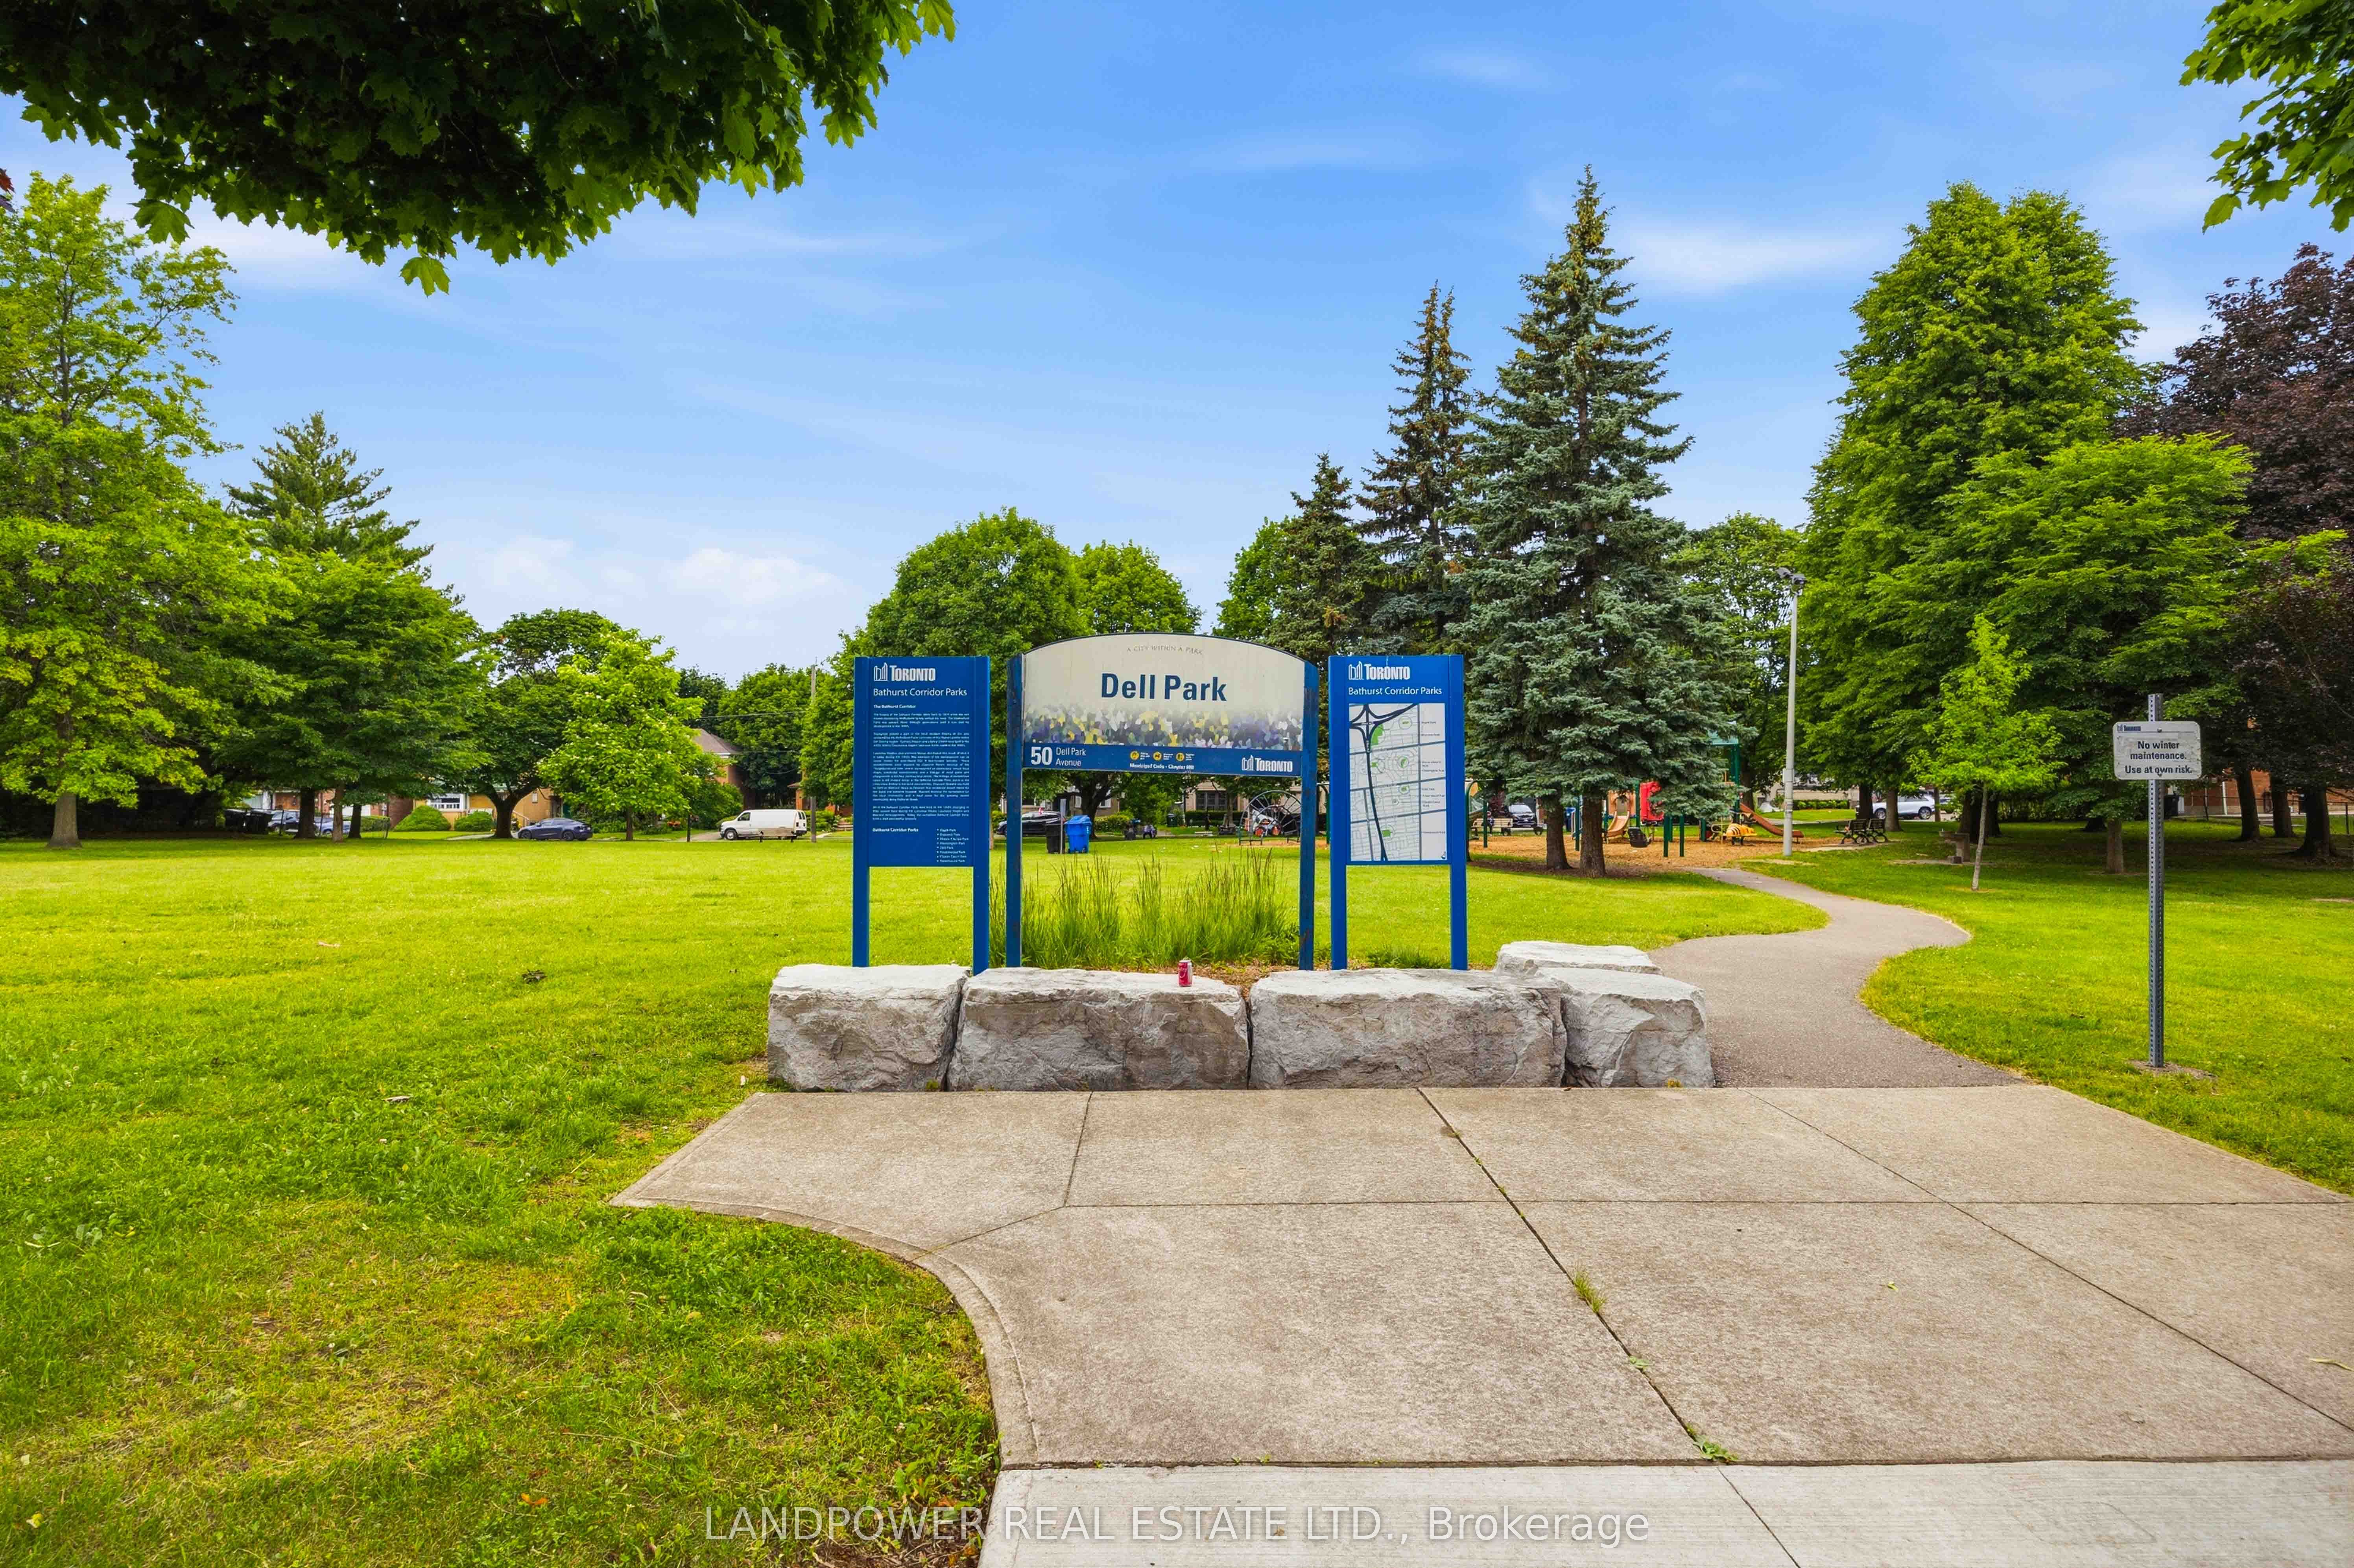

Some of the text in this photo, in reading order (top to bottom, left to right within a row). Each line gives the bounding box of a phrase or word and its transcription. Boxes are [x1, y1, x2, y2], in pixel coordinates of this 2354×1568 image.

[889, 665, 936, 681] TORONTO
[1363, 664, 1410, 680] TORONTO
[873, 687, 967, 696] Bathurst Corridor Parks
[1101, 673, 1227, 701] Dell Park
[1385, 686, 1419, 695] Corridor
[1421, 686, 1442, 695] Parks
[2137, 740, 2180, 749] No winter
[1031, 746, 1053, 765] 50
[1056, 747, 1086, 756] Dell Park
[2130, 751, 2187, 760] maintenance.
[1055, 758, 1082, 766] Avenue
[1254, 757, 1293, 772] TORONTO
[2125, 765, 2142, 774] Use
[2144, 766, 2153, 774] at
[2175, 765, 2192, 774] risk.
